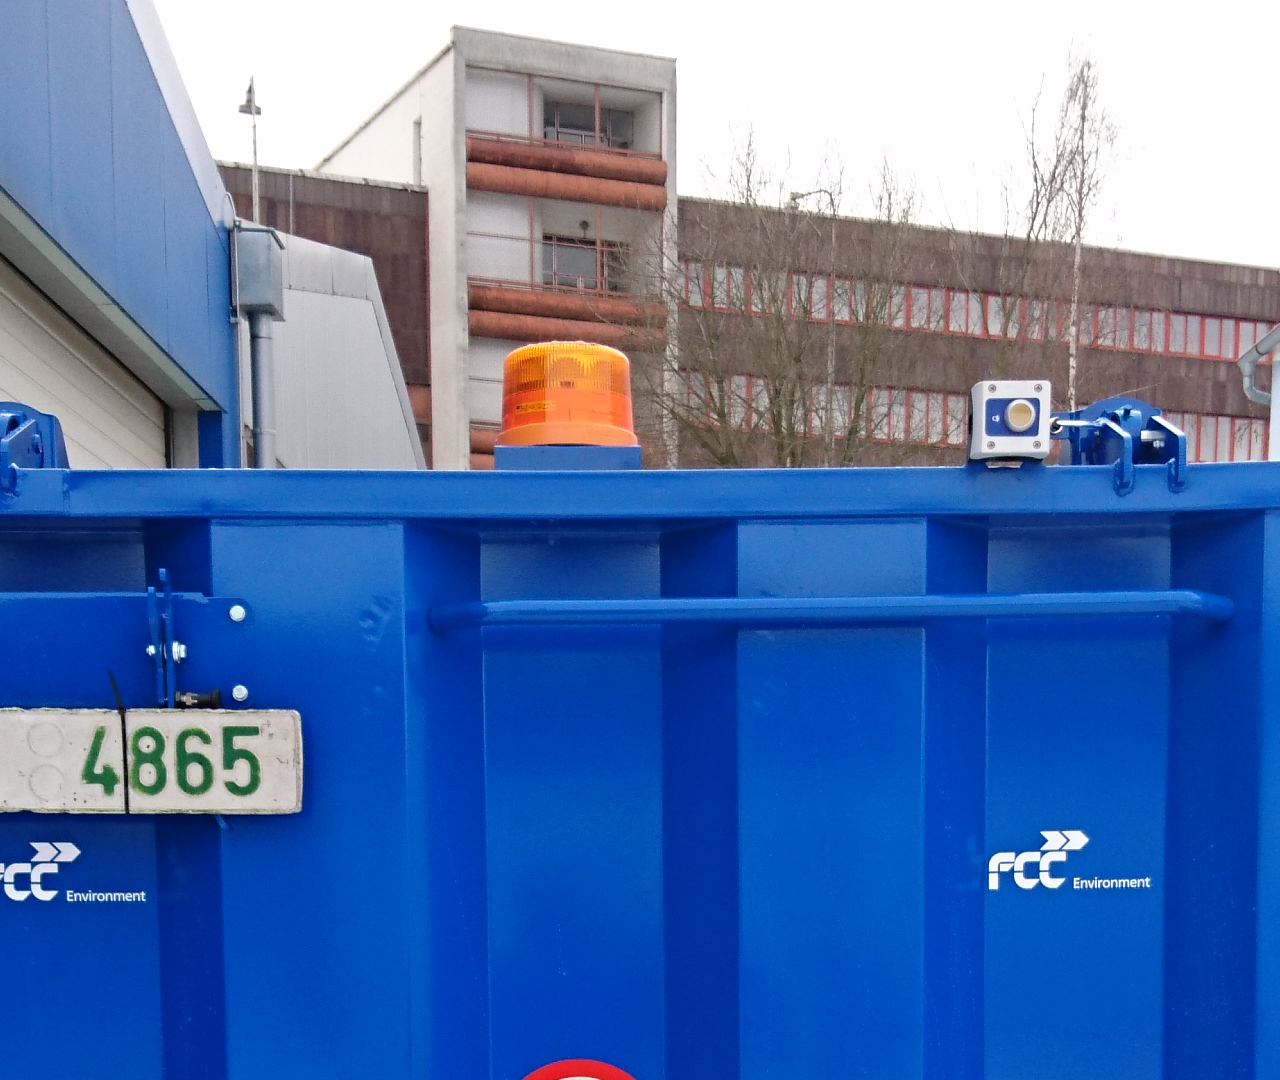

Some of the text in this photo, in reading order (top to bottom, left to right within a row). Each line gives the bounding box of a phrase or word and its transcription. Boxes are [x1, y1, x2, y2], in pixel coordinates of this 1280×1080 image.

[80, 725, 261, 797] 4865
[1072, 876, 1151, 890] Environment
[66, 889, 147, 904] Environment
